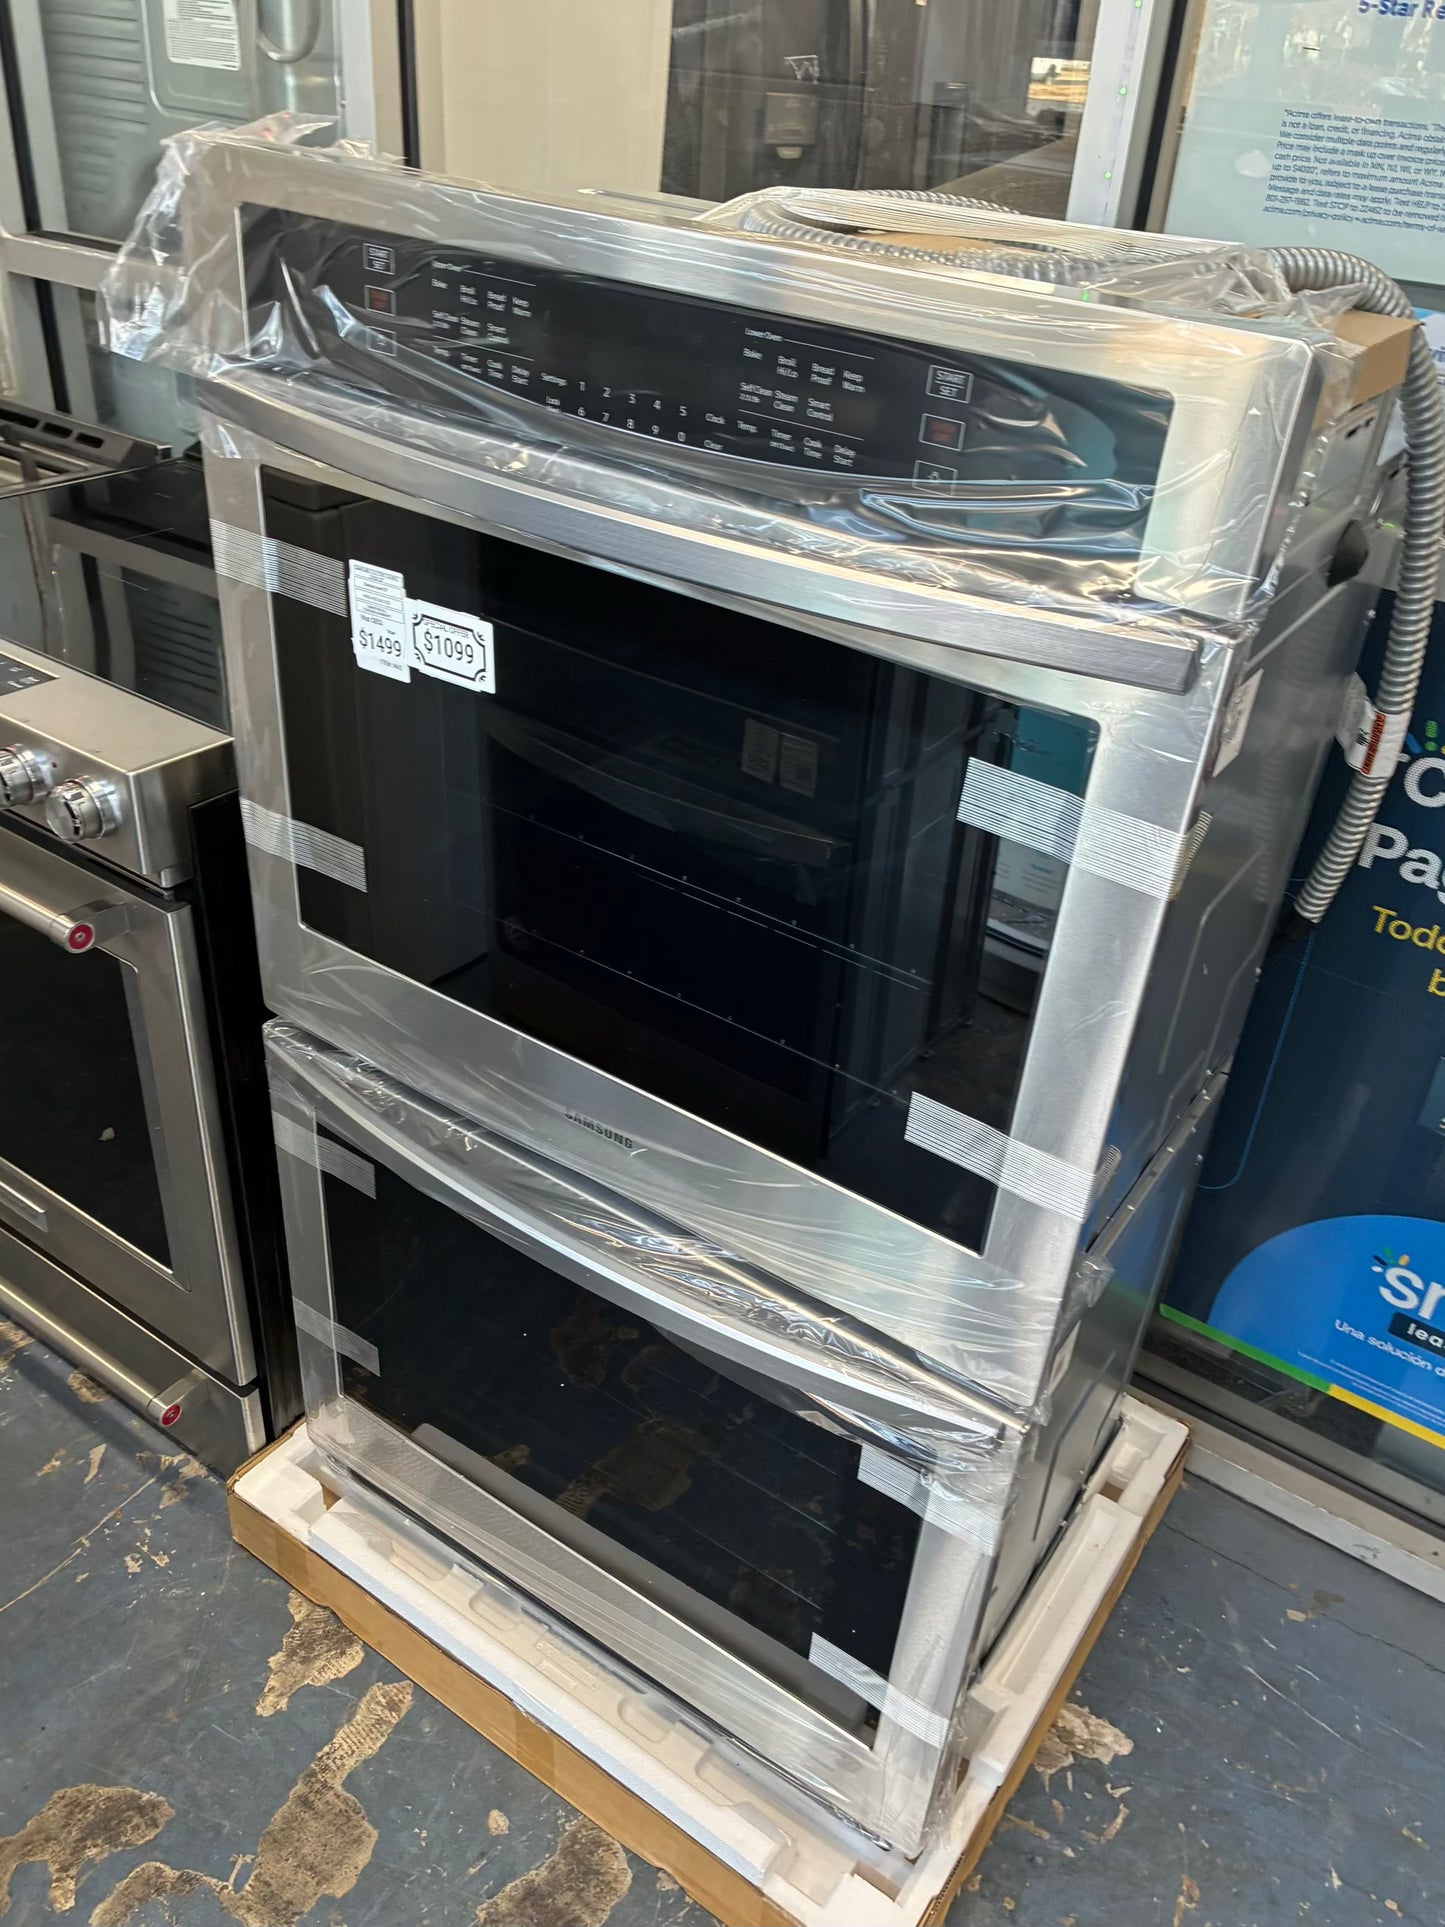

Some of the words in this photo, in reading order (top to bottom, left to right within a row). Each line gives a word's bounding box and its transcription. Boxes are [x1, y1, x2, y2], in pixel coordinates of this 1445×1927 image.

[580, 381, 586, 392] 1
[602, 386, 612, 398] 2
[628, 392, 636, 404] 3
[653, 400, 662, 410] 4
[679, 406, 688, 417] 5
[577, 406, 586, 417] 6
[602, 412, 610, 422] 7
[626, 418, 635, 430] 8
[652, 424, 660, 435] 9
[678, 431, 686, 442] 0
[359, 627, 402, 658] $1499
[424, 628, 474, 664] $1099
[1334, 1319, 1366, 1341] Una
[1367, 1336, 1433, 1371] solución
